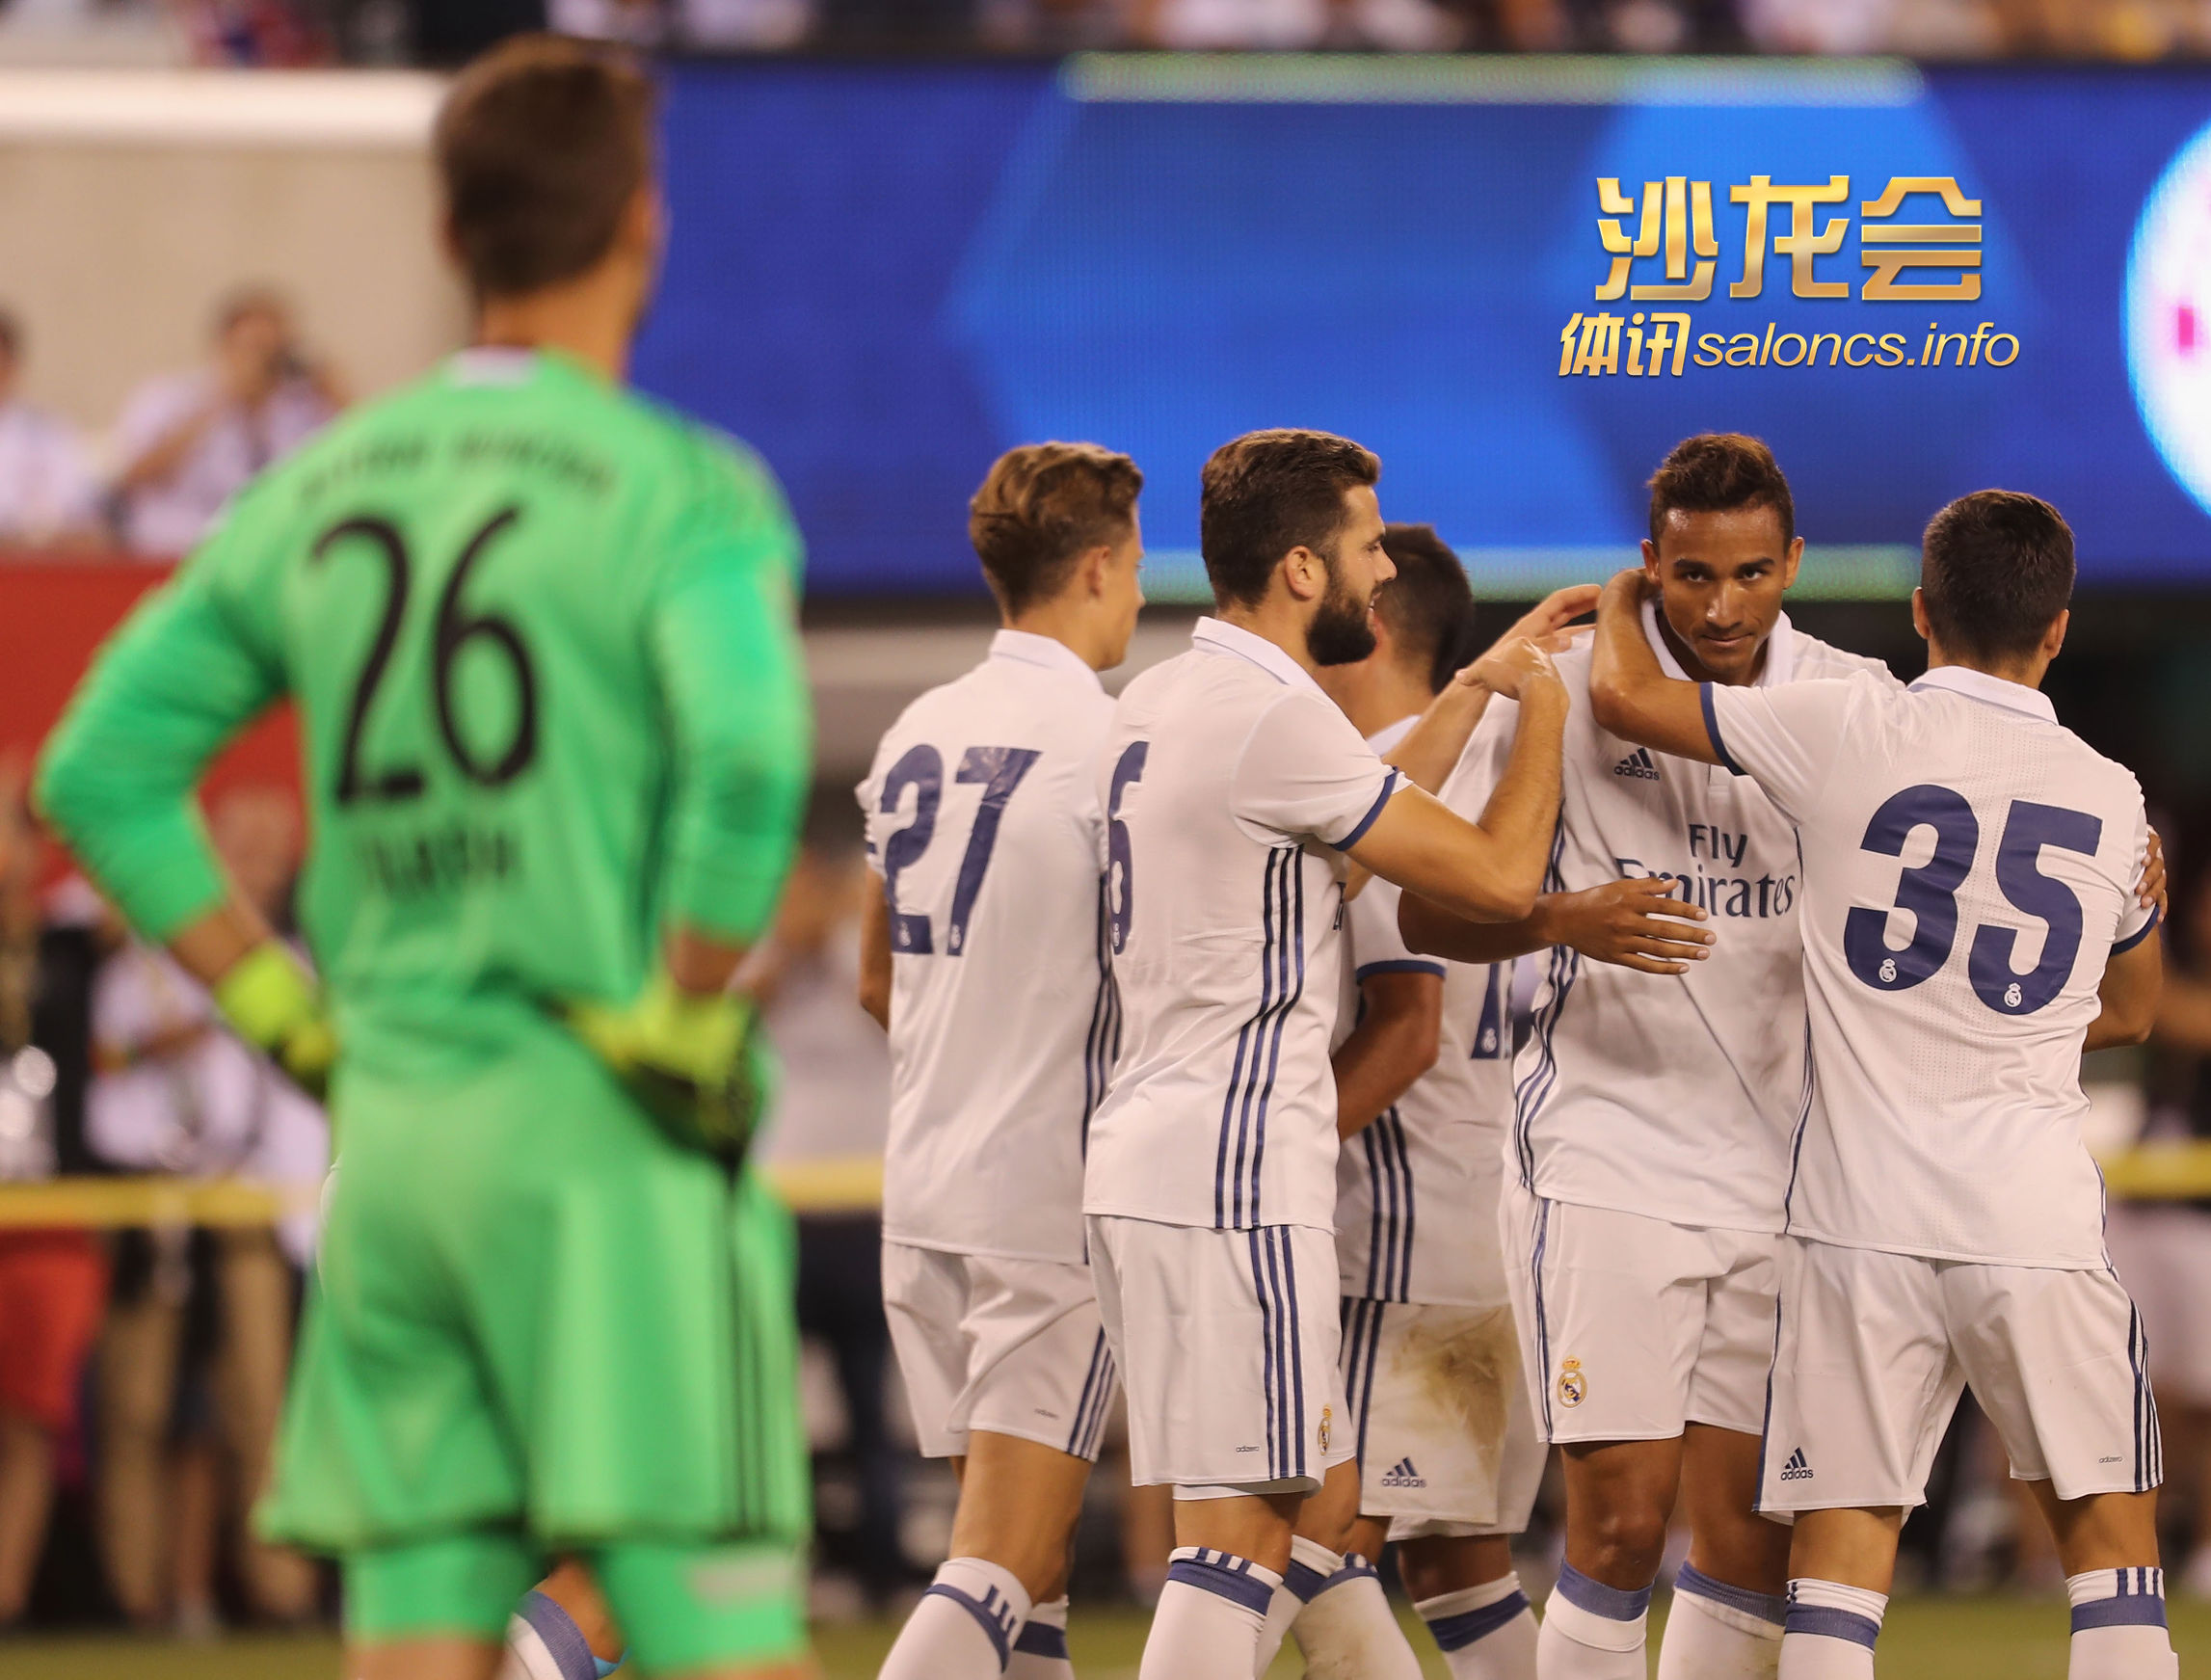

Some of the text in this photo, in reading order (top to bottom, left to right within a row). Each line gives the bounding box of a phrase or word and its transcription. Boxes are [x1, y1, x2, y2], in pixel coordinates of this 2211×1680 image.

[309, 502, 540, 808] 26
[1613, 765, 1660, 781] adidas
[879, 743, 1044, 956] 27
[1689, 823, 1748, 868] Fly
[1843, 784, 2103, 1016] 35
[1381, 1476, 1426, 1488] adidas
[1780, 1468, 1814, 1481] adidas
